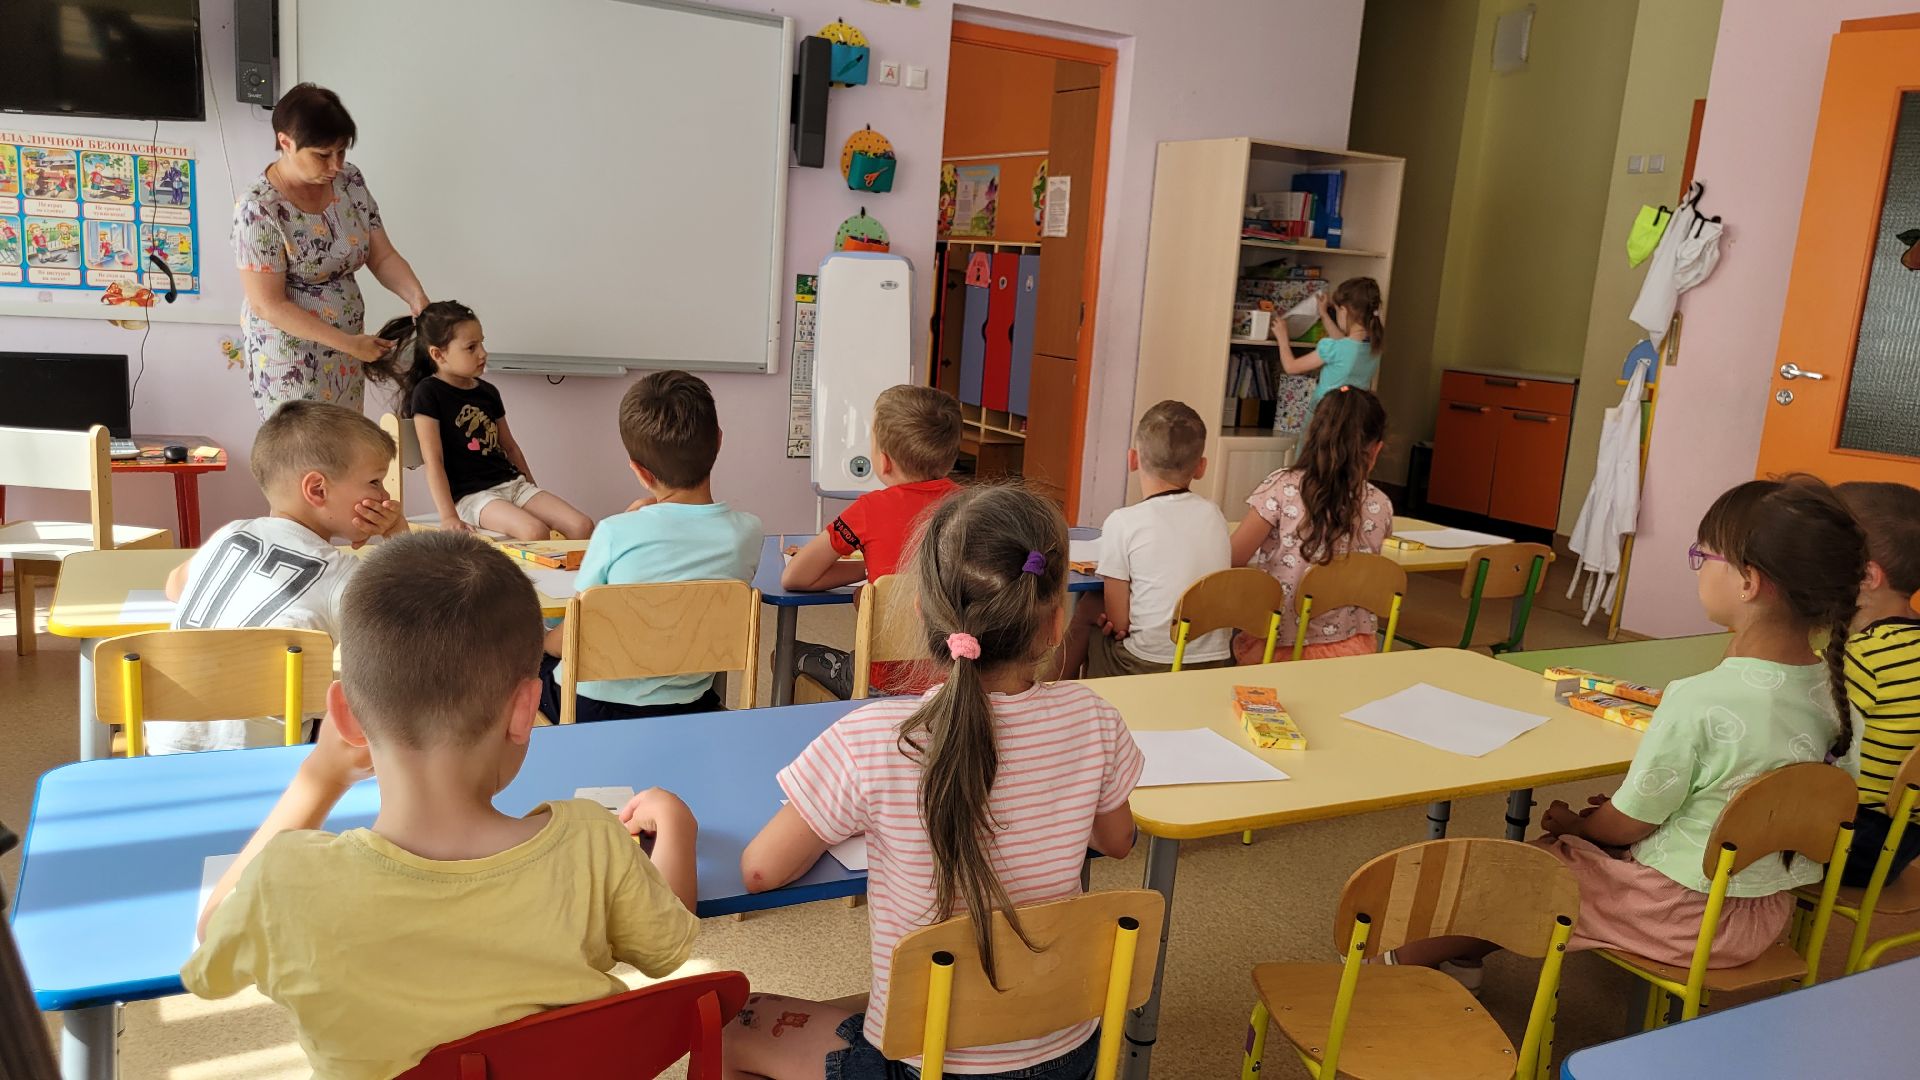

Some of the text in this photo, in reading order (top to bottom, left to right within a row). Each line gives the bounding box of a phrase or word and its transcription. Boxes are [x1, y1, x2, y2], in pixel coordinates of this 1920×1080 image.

[28, 134, 84, 148] ЛИЧНОЙ
[88, 139, 187, 157] БЕЗОПАСНОСТИ
[177, 531, 329, 628] 07
